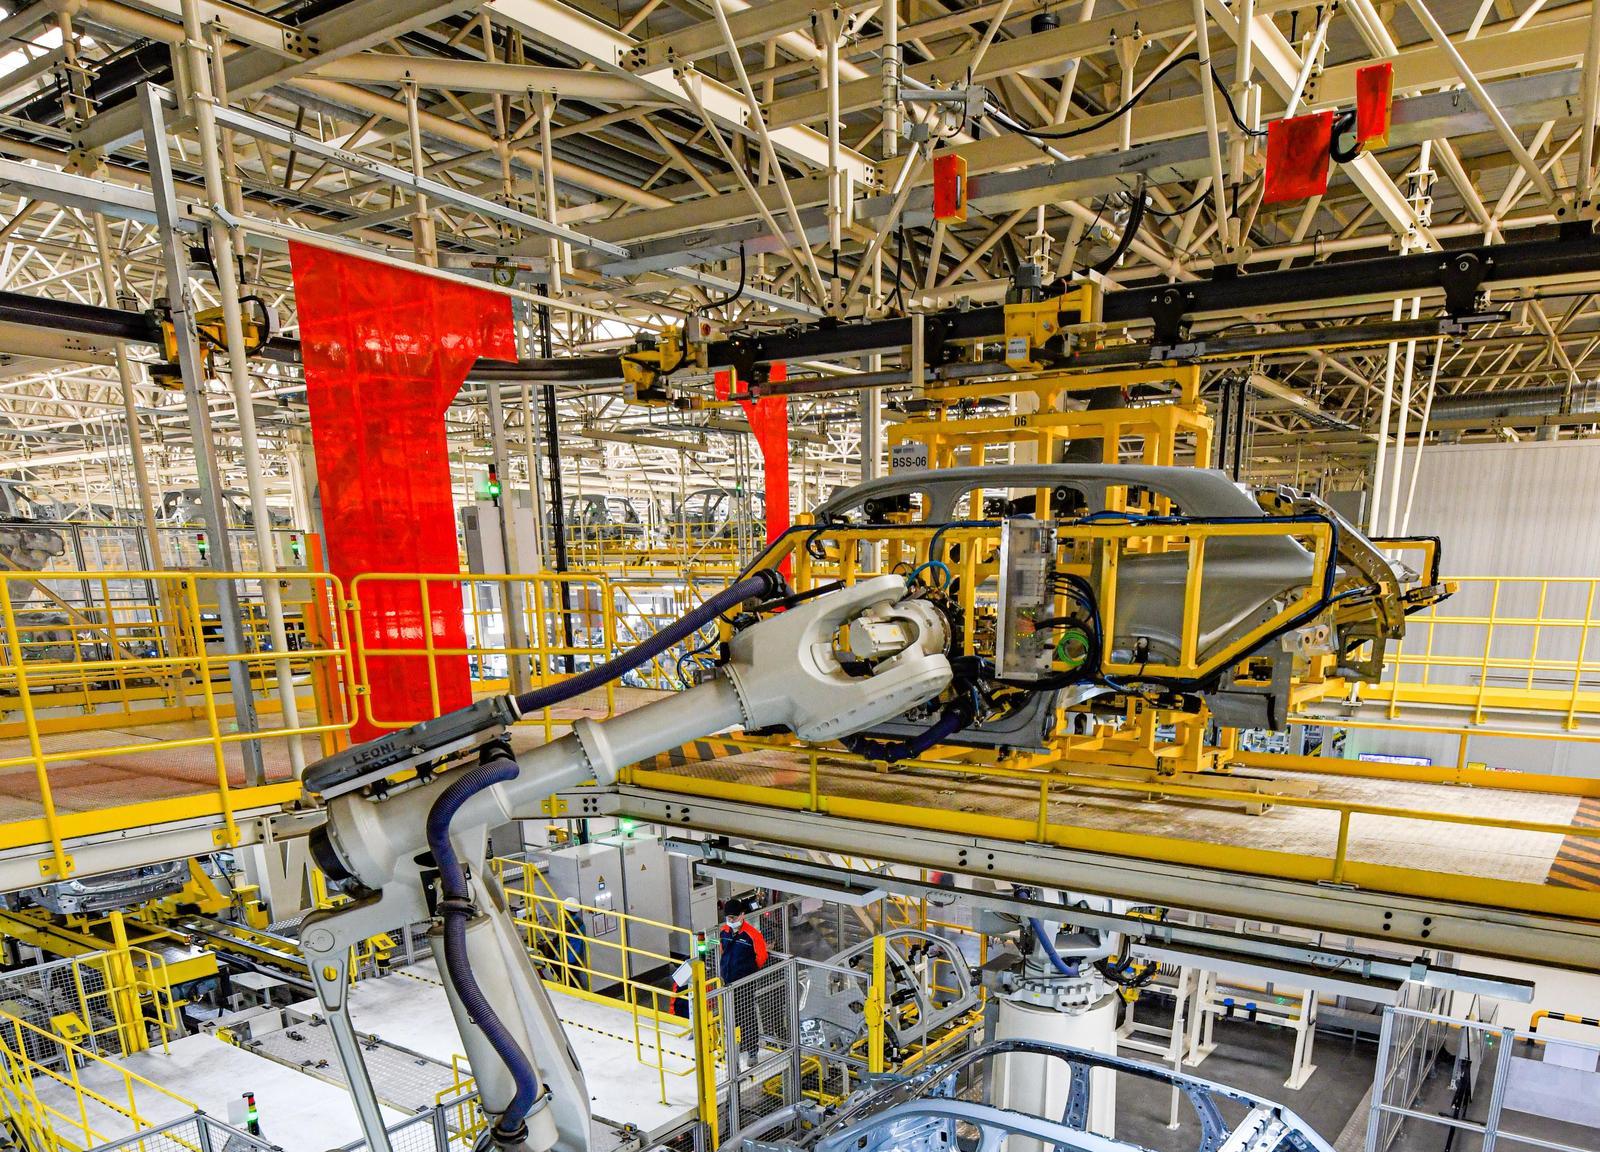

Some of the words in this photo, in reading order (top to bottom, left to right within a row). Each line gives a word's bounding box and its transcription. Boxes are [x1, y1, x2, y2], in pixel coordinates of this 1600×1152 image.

[1014, 416, 1027, 427] 06
[892, 456, 927, 468] BSS-06
[352, 741, 397, 765] LEONI
